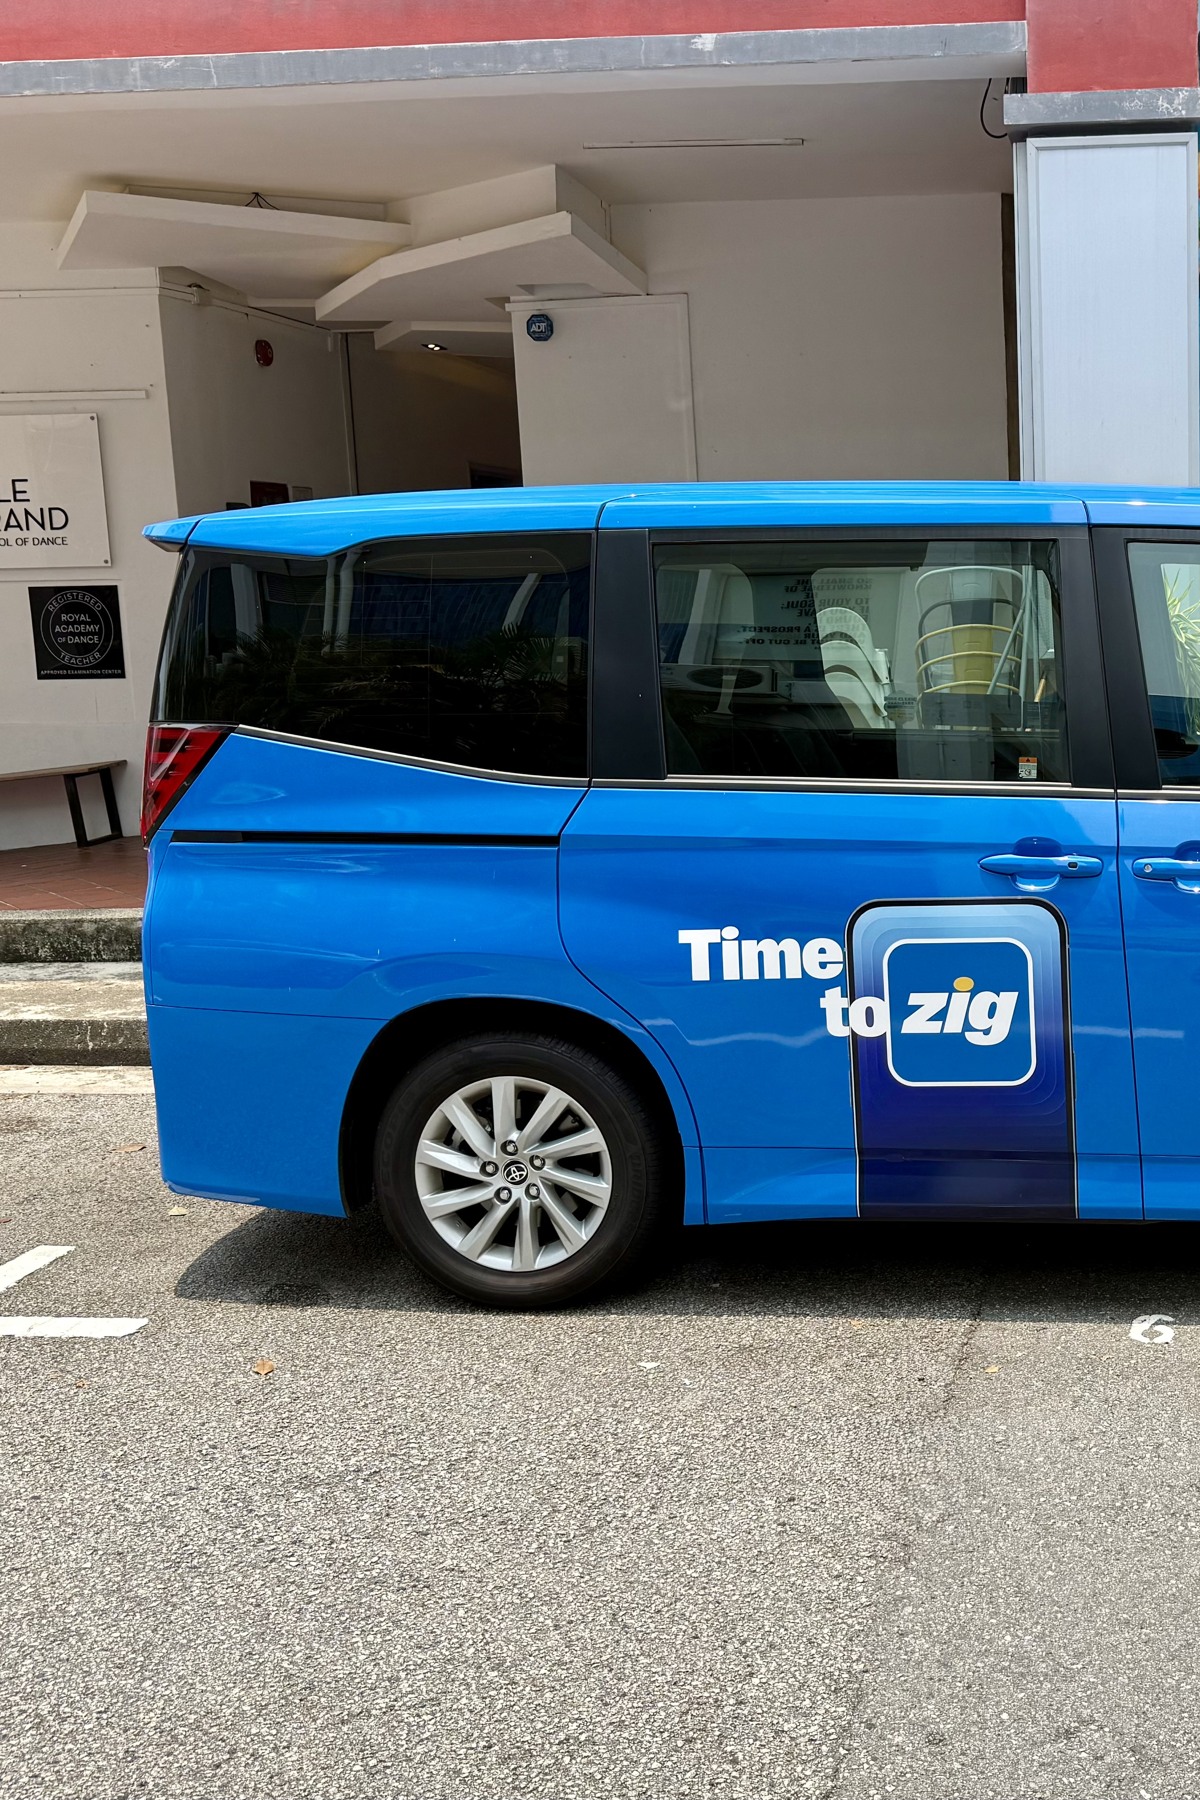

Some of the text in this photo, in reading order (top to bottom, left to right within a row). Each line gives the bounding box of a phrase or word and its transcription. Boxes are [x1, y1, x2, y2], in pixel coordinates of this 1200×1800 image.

[531, 323, 547, 332] ADT
[0, 507, 69, 531] AND
[15, 537, 30, 547] OF
[32, 536, 69, 546] DANCE
[48, 593, 102, 612] REGISTERED
[61, 613, 91, 622] ROYAL
[55, 624, 100, 633] ACADEMY
[67, 636, 99, 644] DANCE
[60, 652, 102, 665] TEACHER
[678, 926, 844, 981] Time
[820, 976, 1019, 1046] to zig
[1129, 1314, 1176, 1344] 6
